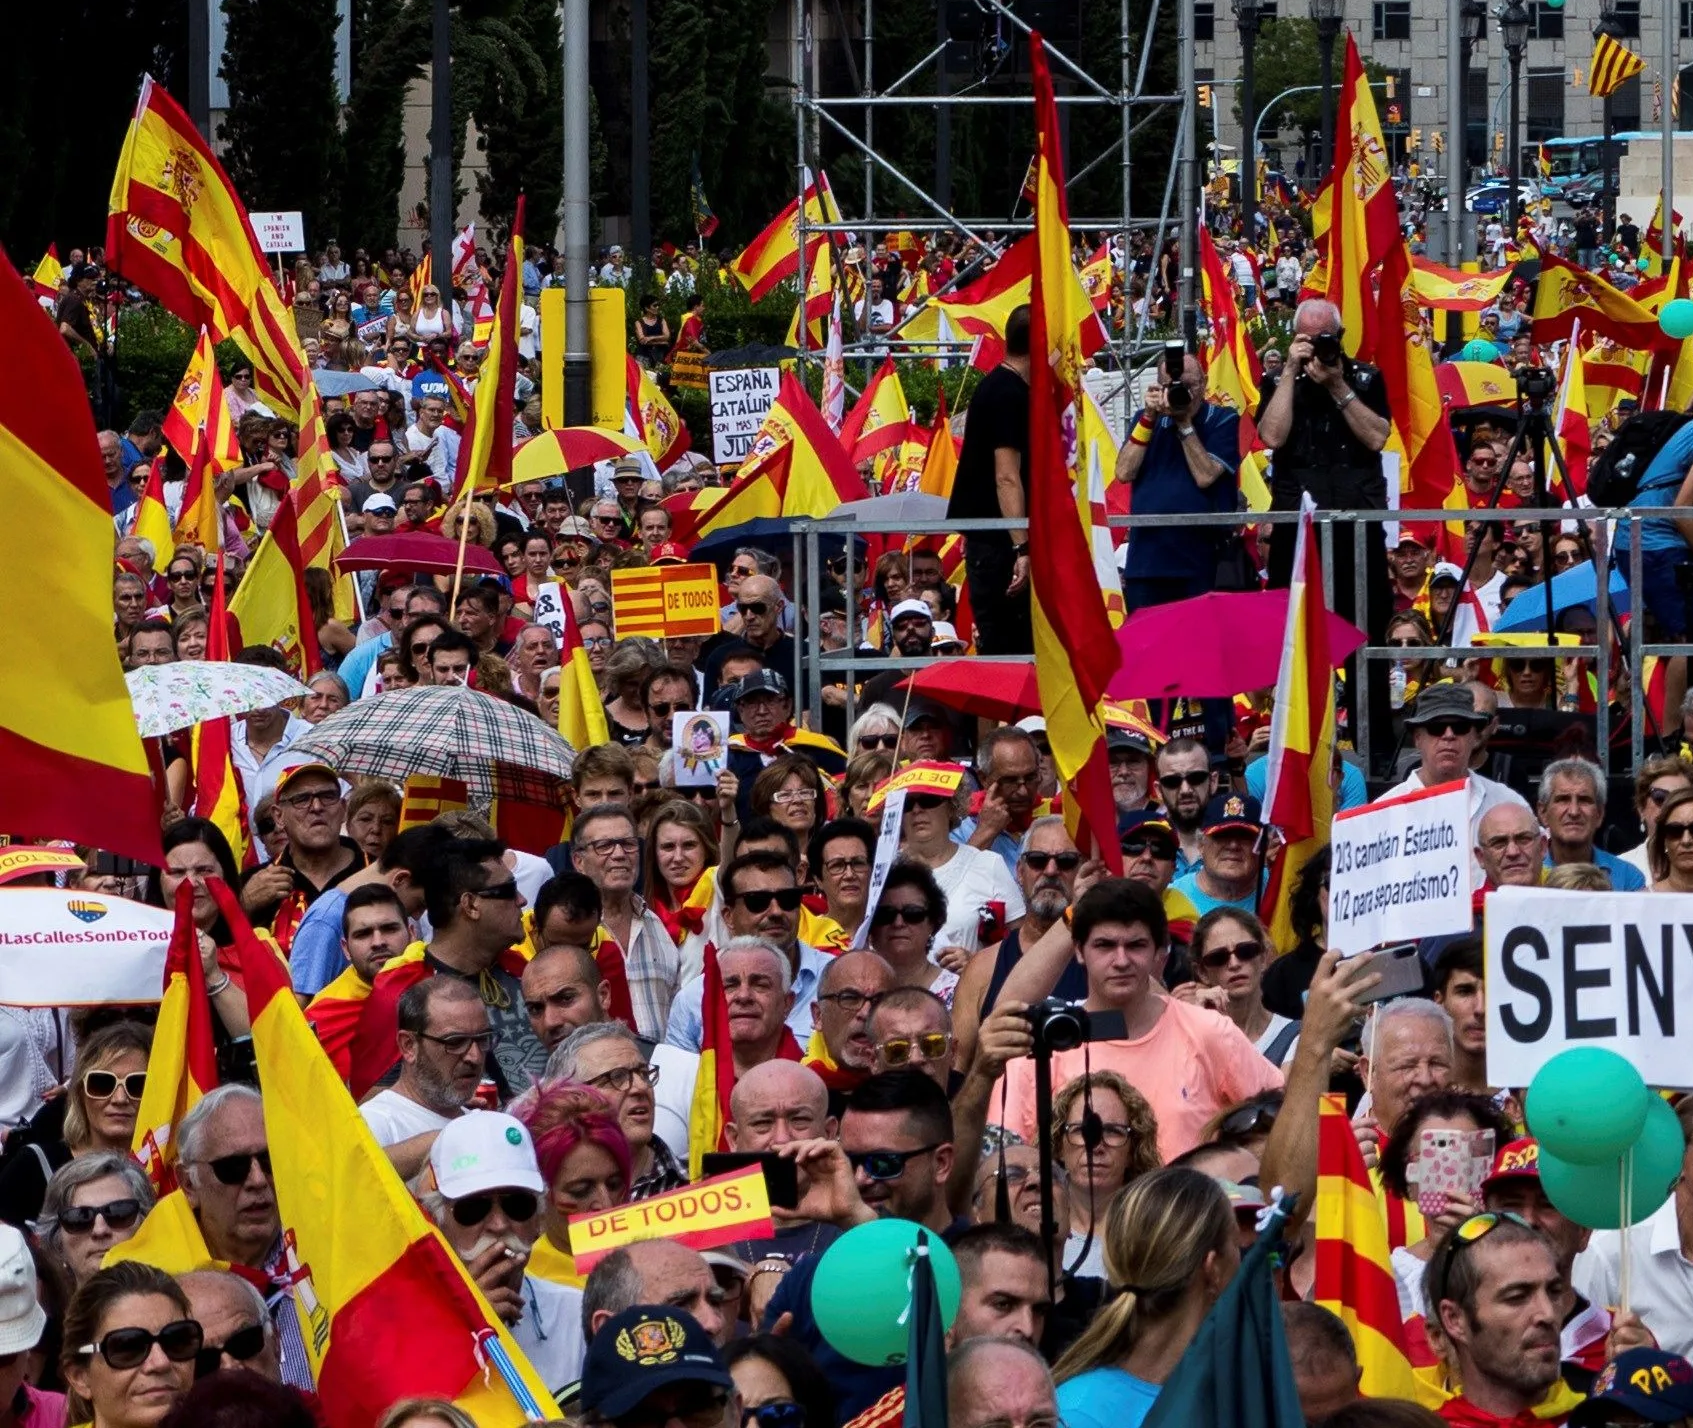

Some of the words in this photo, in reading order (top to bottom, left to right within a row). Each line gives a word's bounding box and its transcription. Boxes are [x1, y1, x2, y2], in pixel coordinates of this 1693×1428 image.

[715, 369, 772, 394] ESPAÑA
[711, 393, 772, 418] CATALUÑ
[714, 422, 729, 433] SON
[667, 593, 680, 610] DE
[682, 590, 714, 608] TODOS
[1335, 840, 1351, 875] 2/3
[1355, 830, 1400, 870] cambian
[1403, 820, 1459, 857] Estatuto.
[1333, 889, 1351, 923] 1/2
[1352, 893, 1373, 927] para
[1374, 865, 1460, 915] separatismo?
[589, 1210, 629, 1238] DE
[635, 1185, 753, 1227] TODOS.
